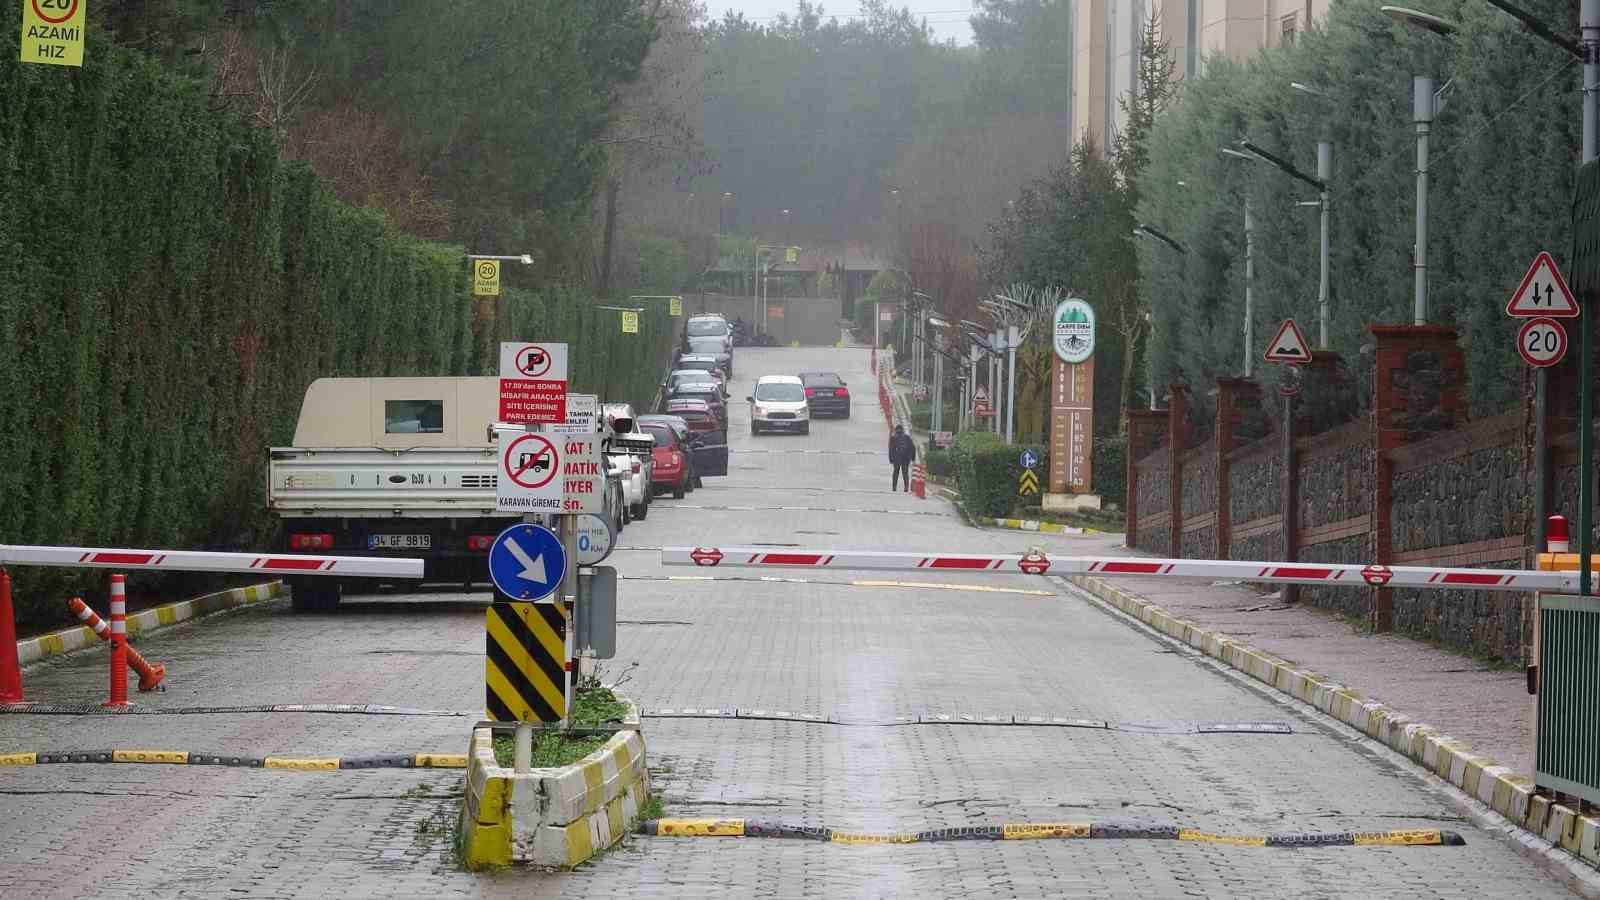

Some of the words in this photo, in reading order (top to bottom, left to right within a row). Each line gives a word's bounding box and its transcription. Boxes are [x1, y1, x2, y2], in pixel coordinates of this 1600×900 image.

[28, 25, 80, 41] AZAMİ
[38, 44, 65, 58] HIZ
[481, 266, 493, 275] 20
[1528, 331, 1557, 352] 20
[500, 497, 530, 507] KARAVAN
[532, 496, 560, 508] GİREMEZ
[374, 535, 385, 545] 34
[407, 535, 429, 545] 9819
[579, 536, 589, 551] 0
